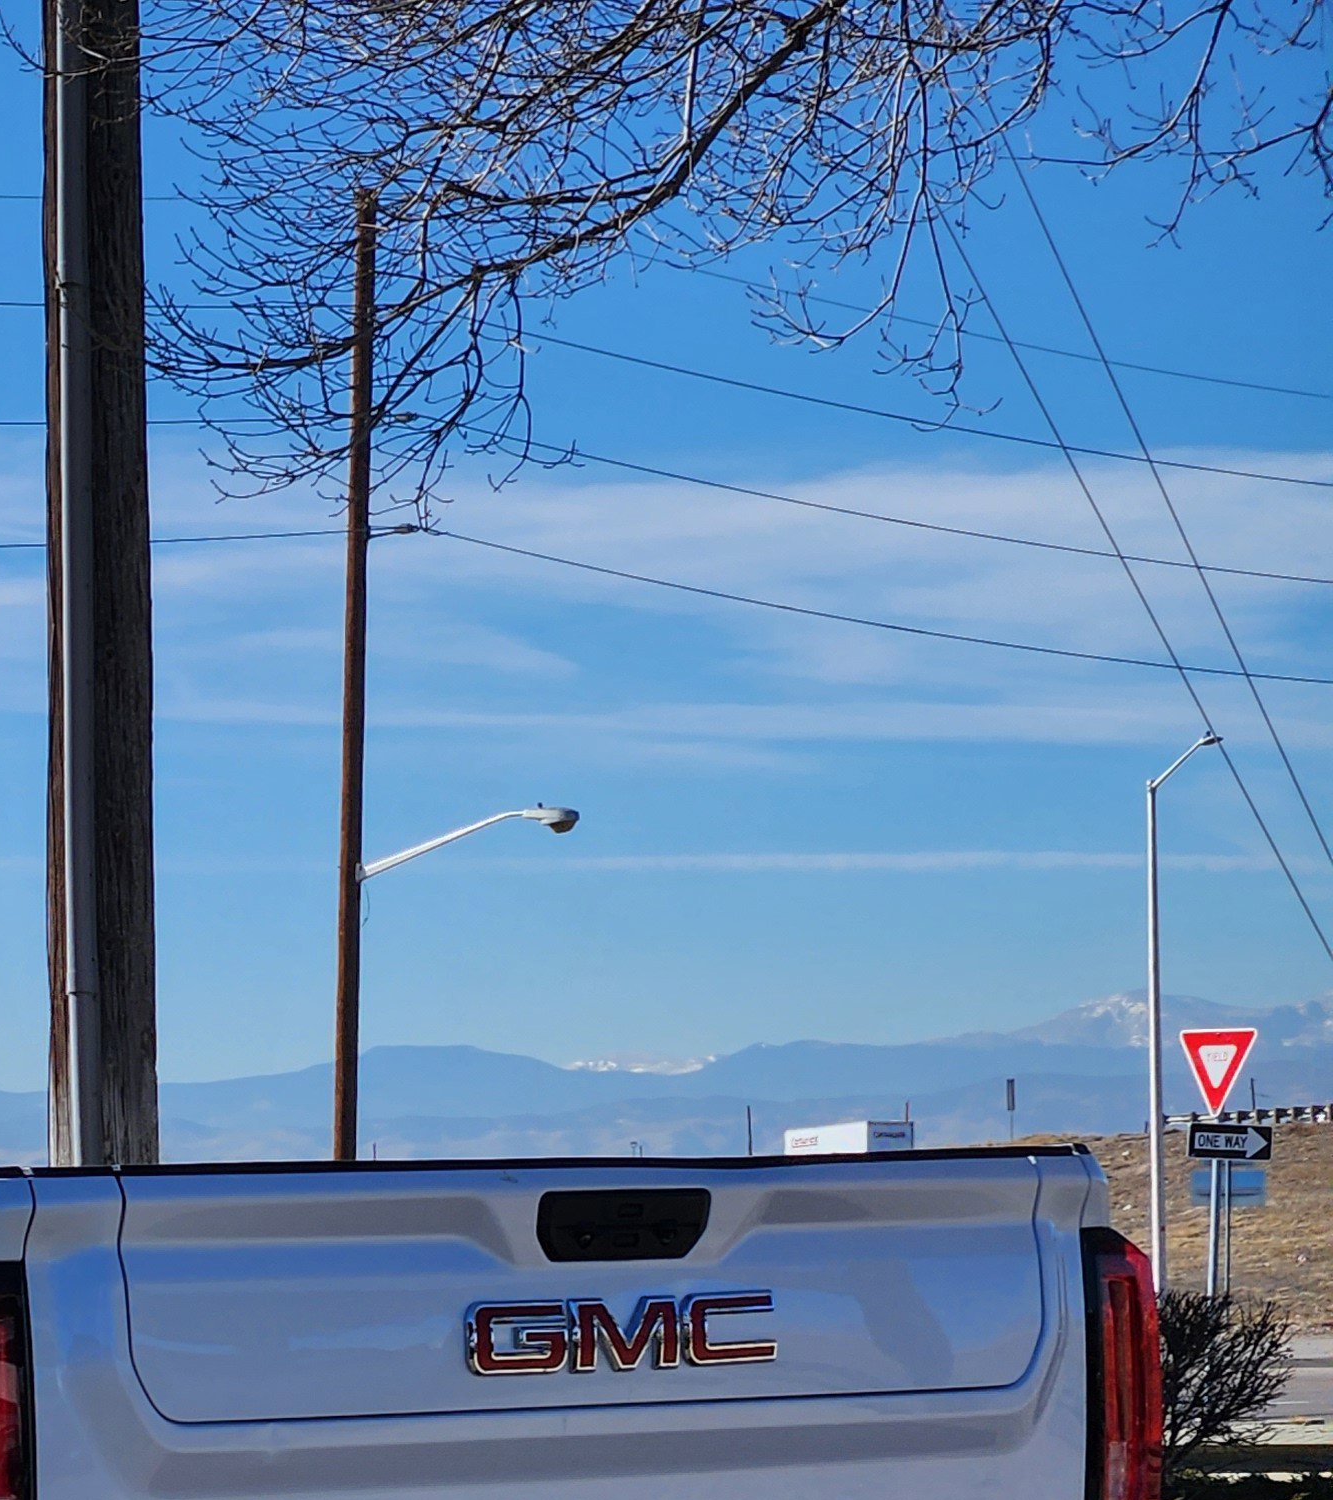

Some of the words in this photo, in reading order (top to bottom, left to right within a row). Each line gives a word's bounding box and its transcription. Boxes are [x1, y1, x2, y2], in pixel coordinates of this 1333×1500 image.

[1197, 1133, 1221, 1148] ONE
[1224, 1135, 1248, 1149] WAY
[463, 1289, 778, 1376] GMC
